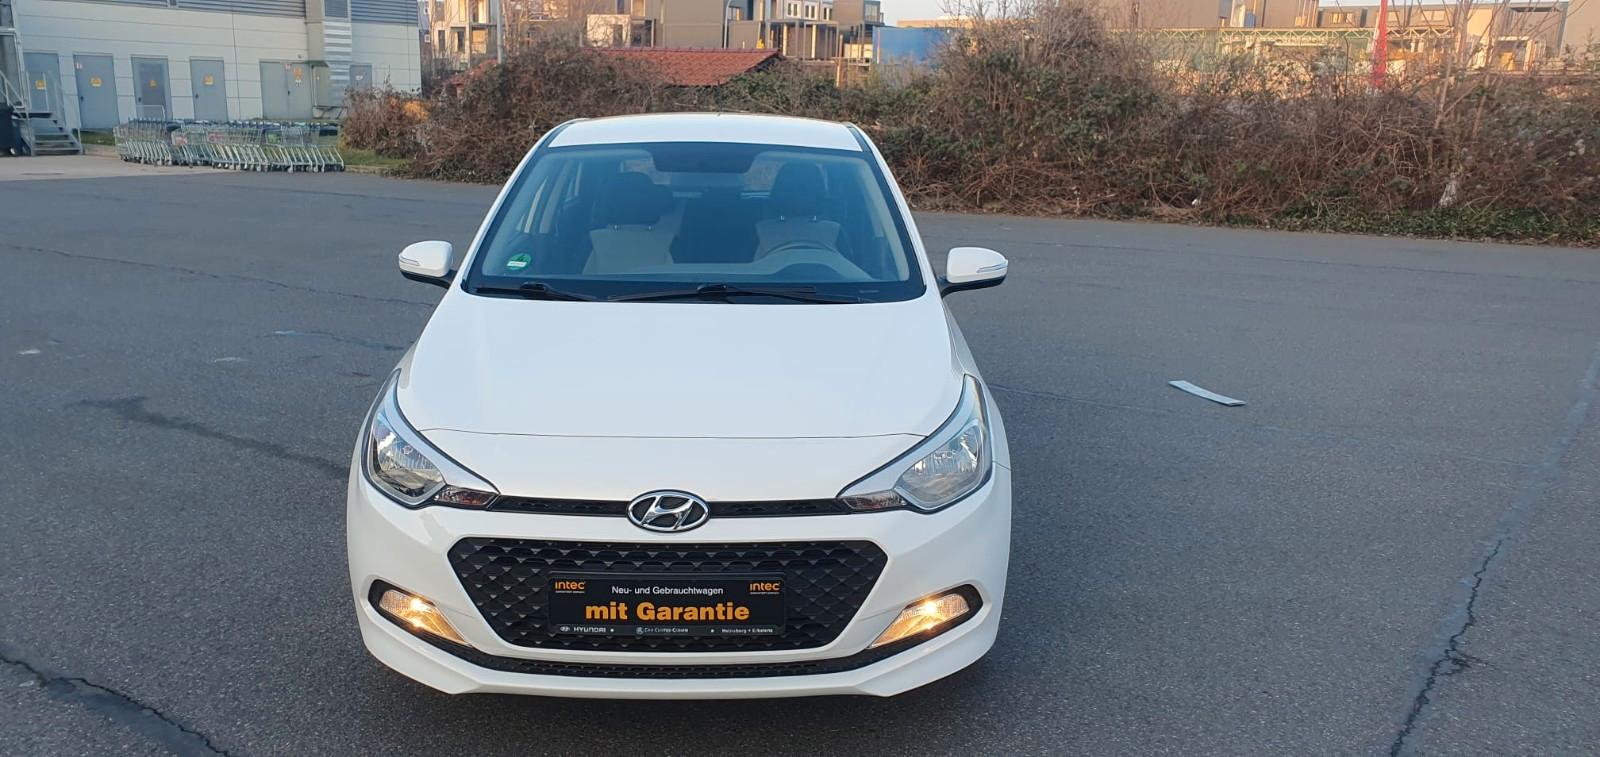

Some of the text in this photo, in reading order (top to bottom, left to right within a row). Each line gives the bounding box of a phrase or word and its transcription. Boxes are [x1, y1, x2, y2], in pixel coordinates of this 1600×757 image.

[555, 581, 585, 590] intec
[749, 582, 780, 591] intec
[611, 586, 724, 596] Neu- und Gebrauchtwagen
[585, 601, 750, 620] mit Garantie
